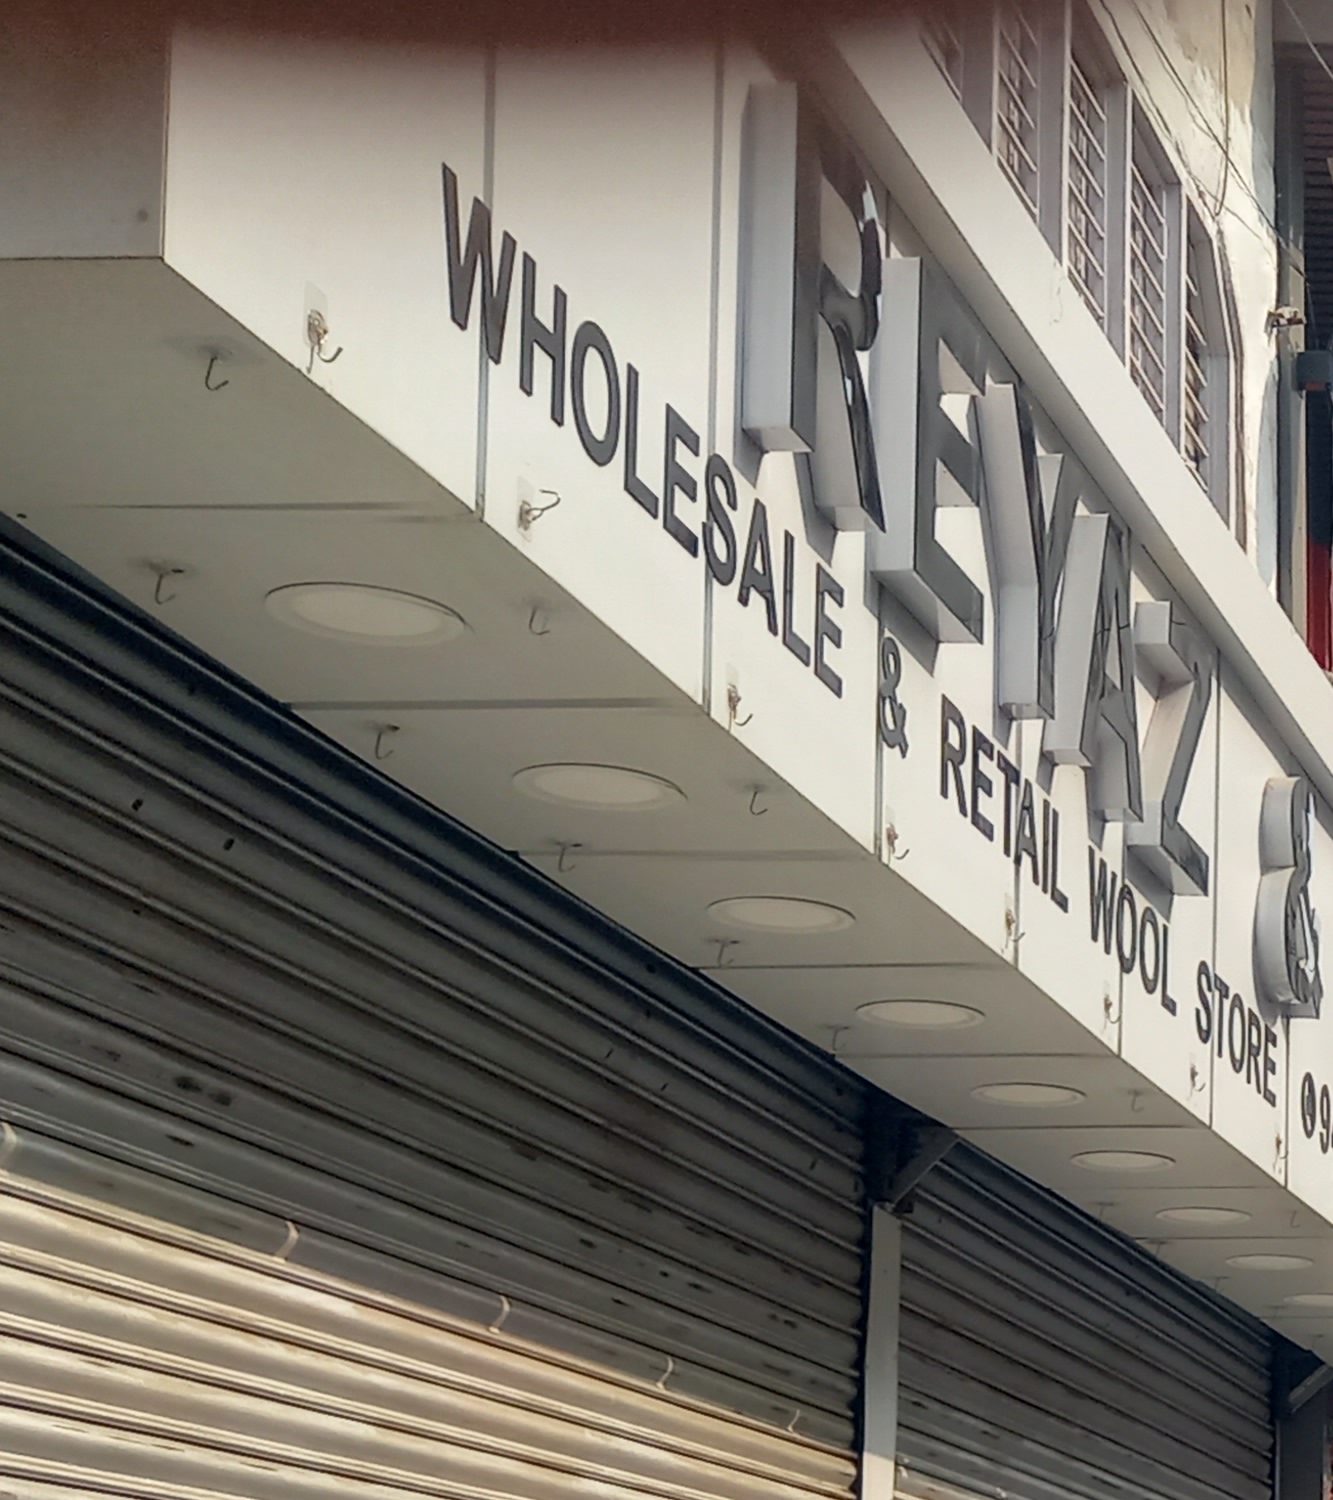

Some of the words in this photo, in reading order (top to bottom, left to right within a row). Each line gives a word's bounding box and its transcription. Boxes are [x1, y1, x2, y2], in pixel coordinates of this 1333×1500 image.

[440, 161, 844, 700] WHOLESALE
[877, 636, 910, 758] &
[940, 693, 1070, 914] RETAIL
[1087, 843, 1178, 1017] WOOL
[1194, 959, 1278, 1108] STORE
[1253, 776, 1323, 1020] &
